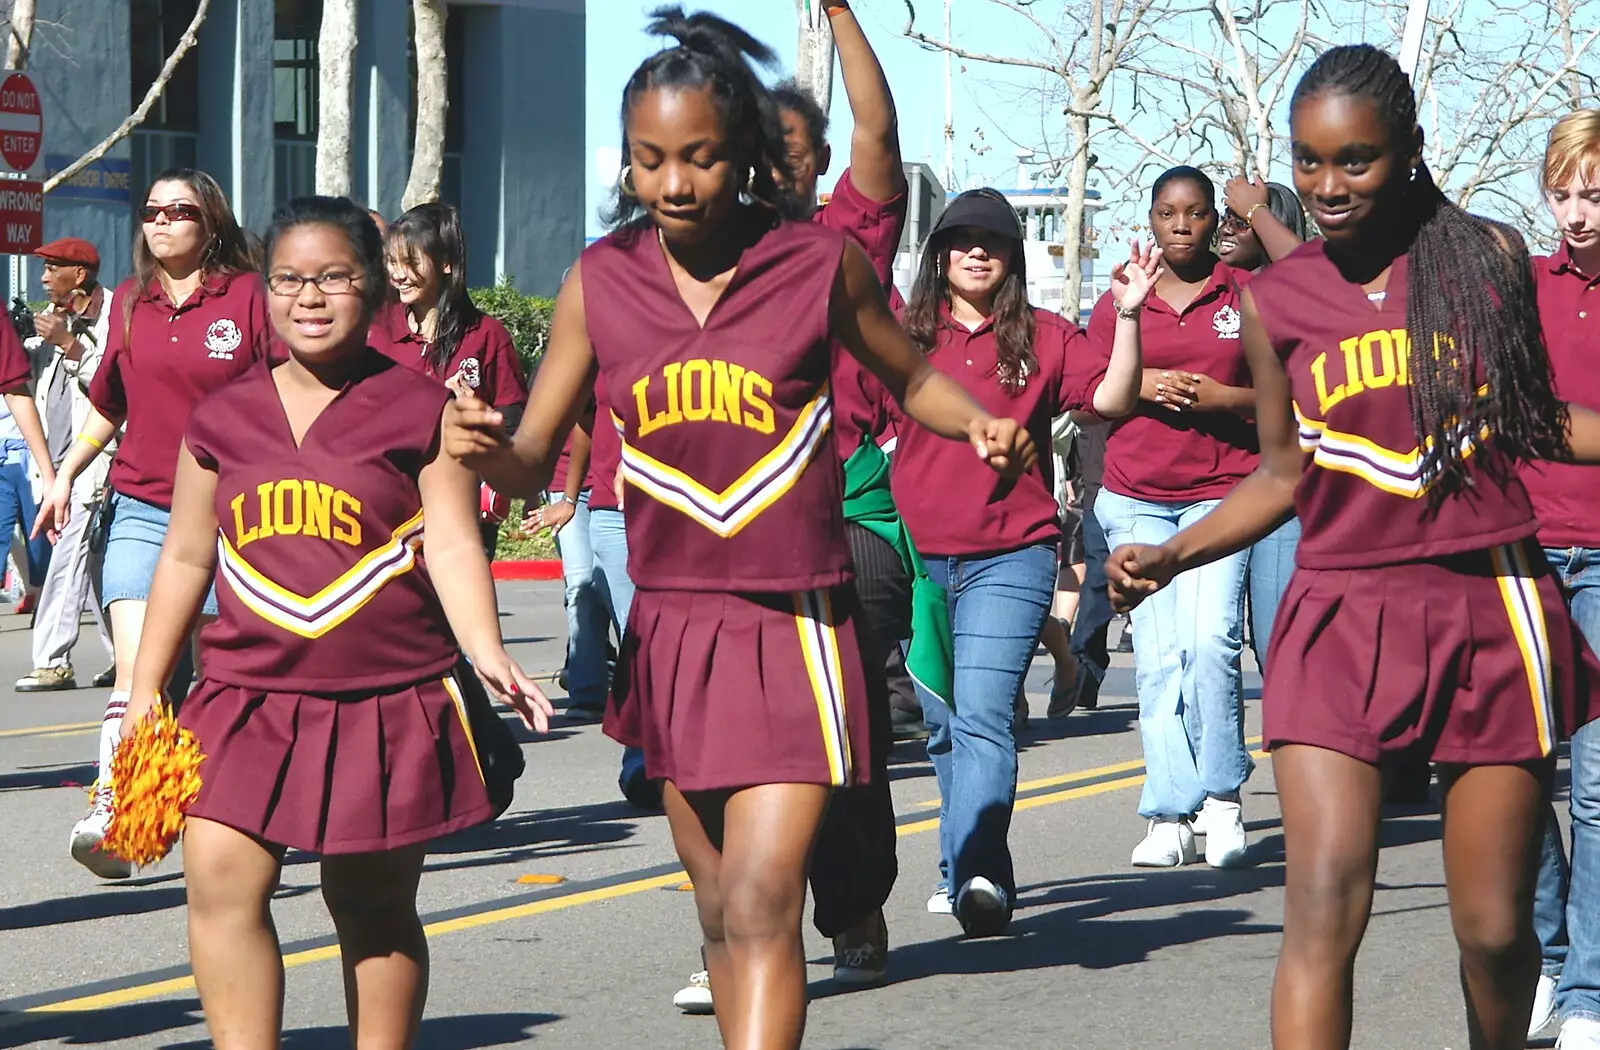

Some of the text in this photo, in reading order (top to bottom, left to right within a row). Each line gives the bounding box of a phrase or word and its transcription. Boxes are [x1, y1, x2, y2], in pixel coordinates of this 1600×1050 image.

[3, 90, 36, 109] DO NOT
[4, 135, 35, 153] ENTER
[0, 190, 42, 212] WRONG
[7, 222, 32, 243] WAY
[632, 358, 776, 438] LIONS
[230, 478, 362, 550] LIONS
